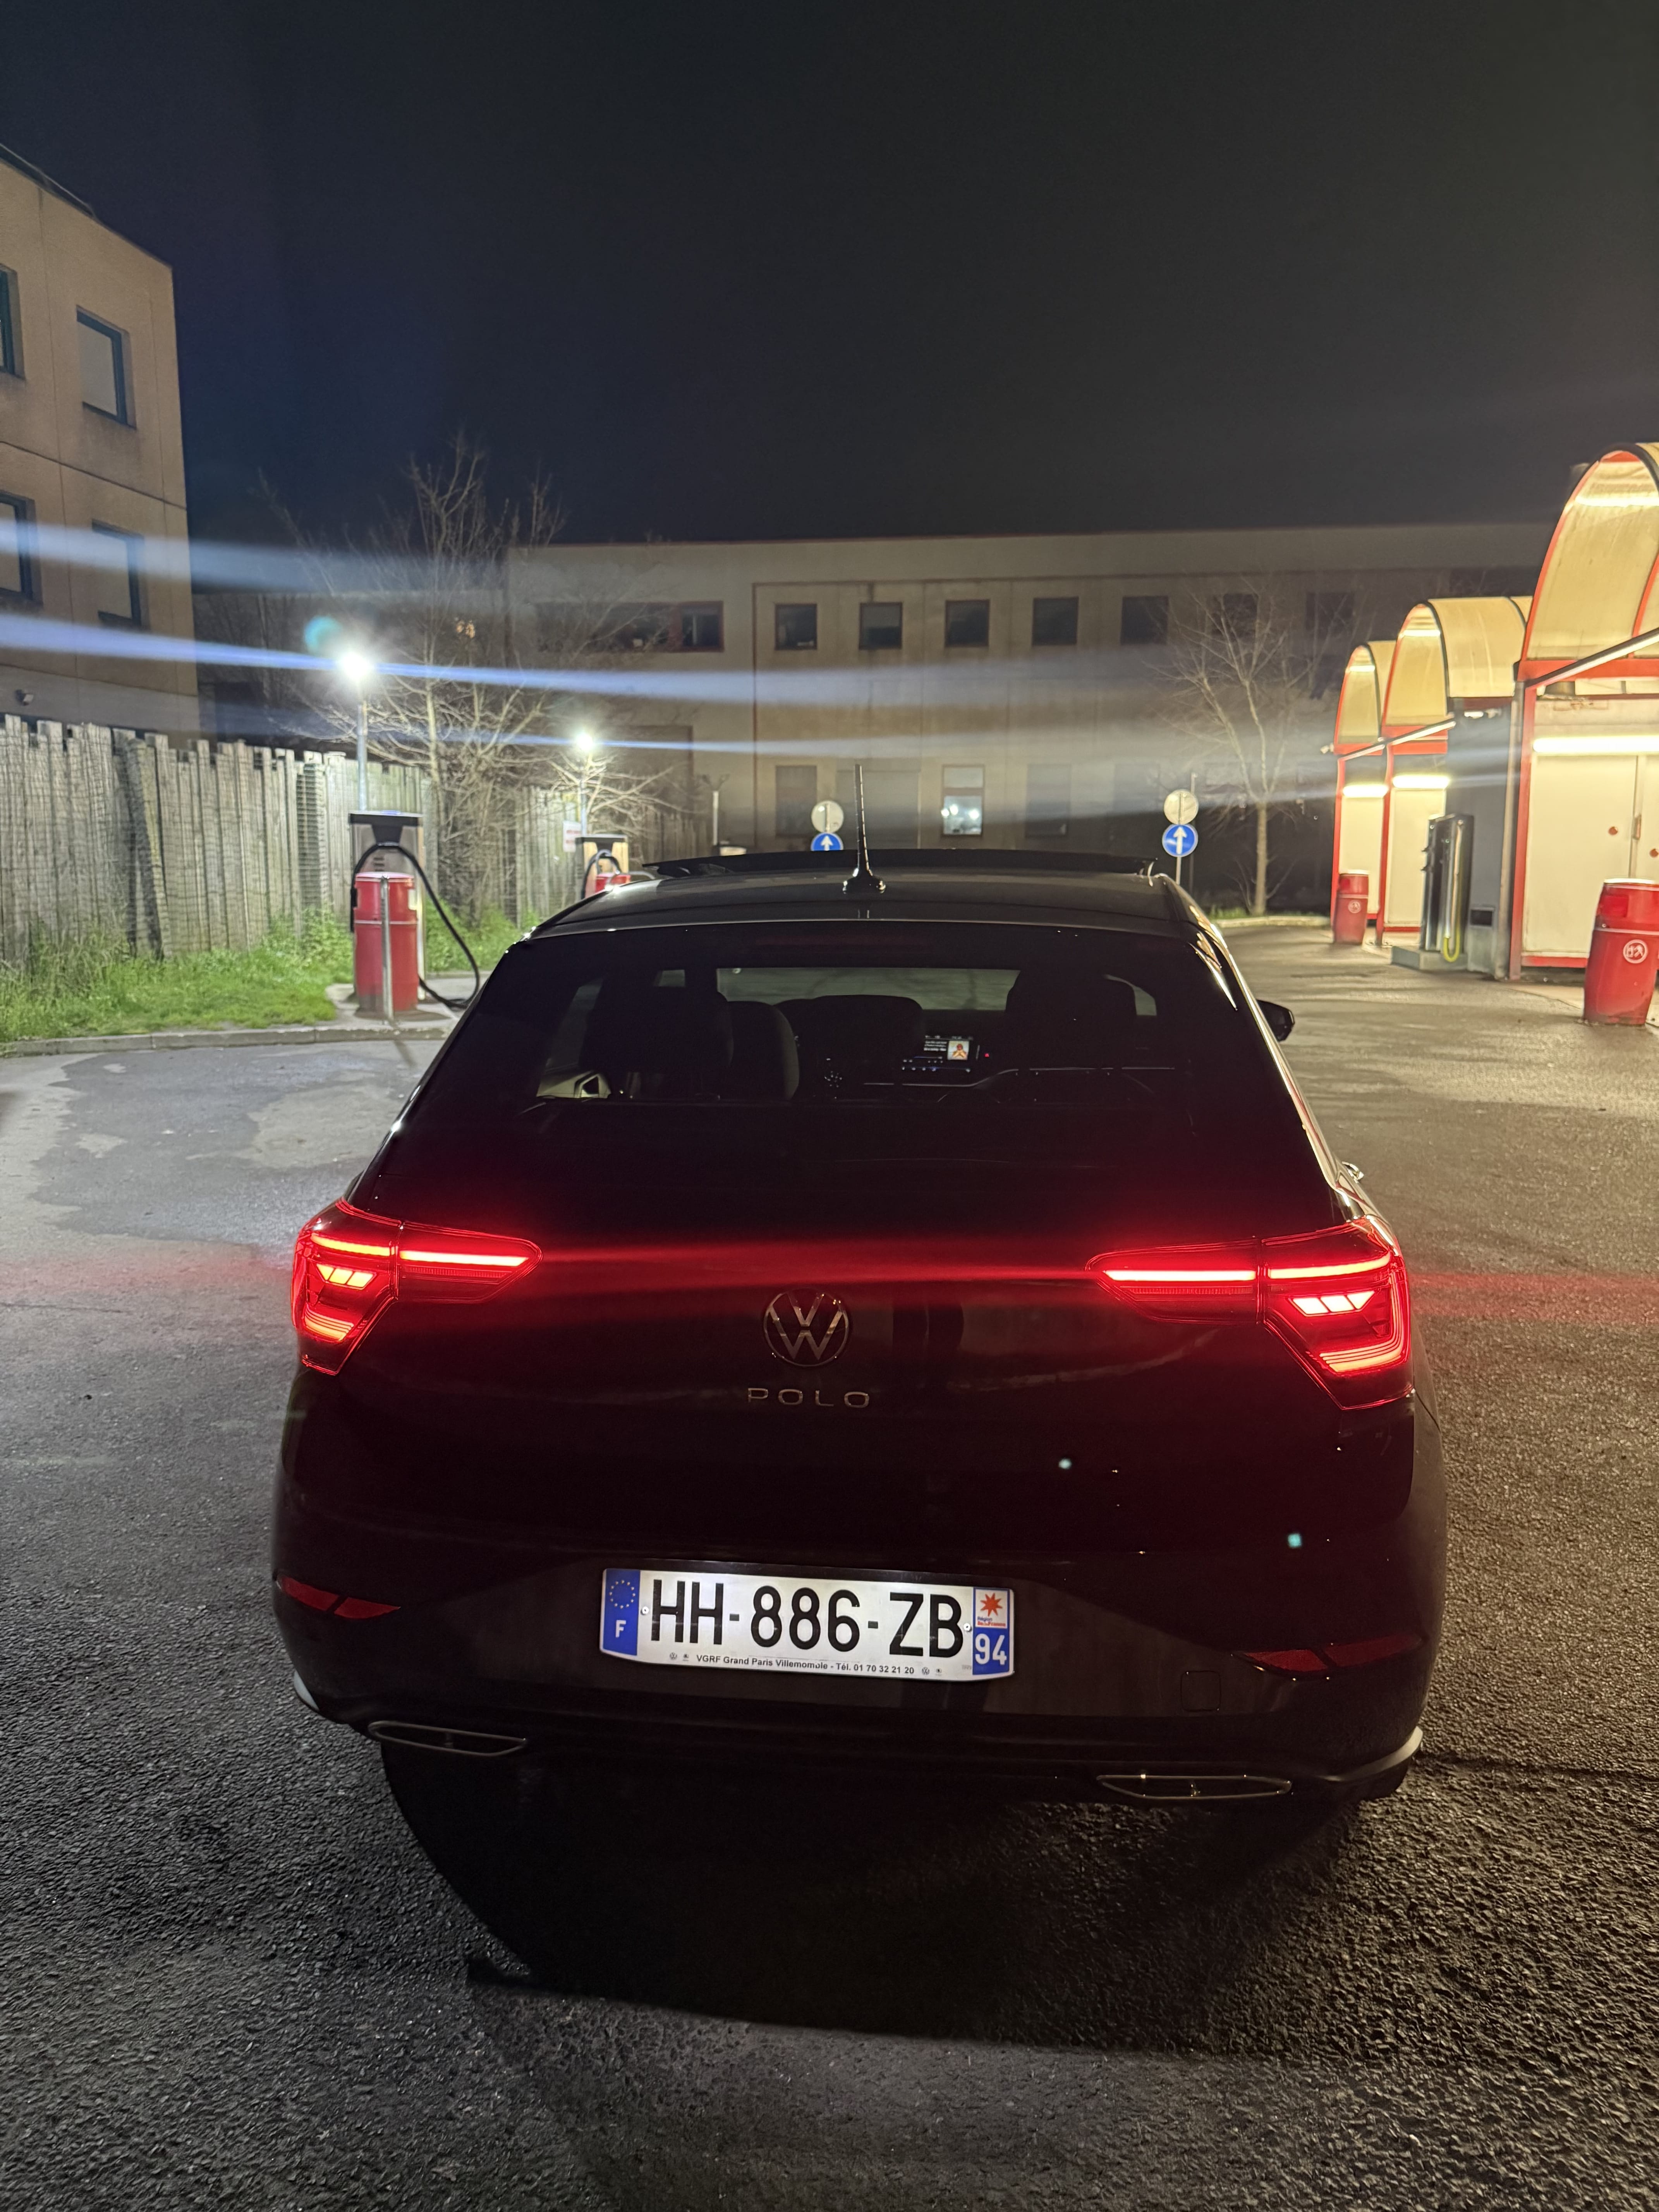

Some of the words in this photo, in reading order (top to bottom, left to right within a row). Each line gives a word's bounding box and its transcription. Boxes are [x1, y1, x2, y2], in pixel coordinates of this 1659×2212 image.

[748, 1388, 869, 1408] POLO
[615, 1620, 626, 1638] F
[651, 1580, 963, 1658] HH-886-ZB
[975, 1633, 1007, 1665] 94
[696, 1654, 721, 1662] VGRF
[723, 1656, 749, 1665] Grand
[752, 1658, 773, 1666] Paris
[836, 1662, 851, 1671] Tél.
